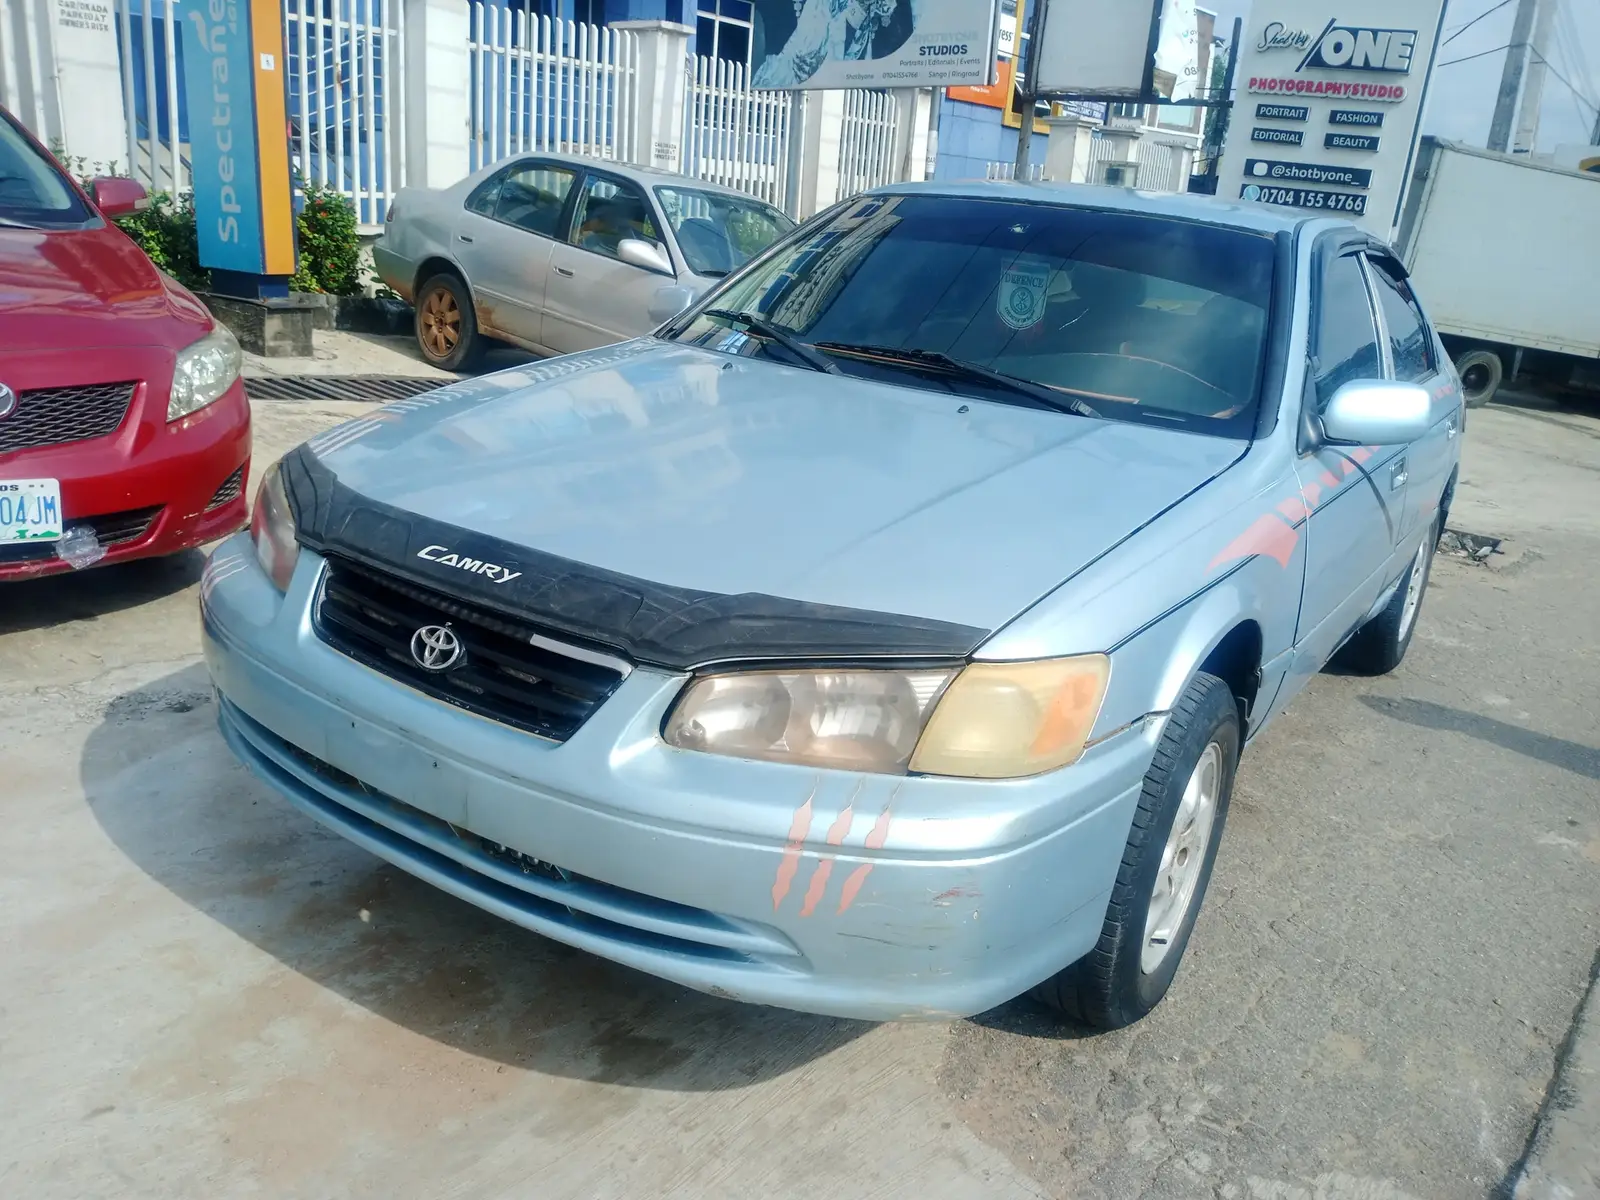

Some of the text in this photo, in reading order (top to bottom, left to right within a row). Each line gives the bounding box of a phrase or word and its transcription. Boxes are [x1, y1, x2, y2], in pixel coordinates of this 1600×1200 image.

[94, 14, 107, 23] AT
[919, 44, 968, 56] STUDIOS
[1320, 29, 1414, 71] ONE
[960, 57, 980, 66] Events
[1259, 106, 1305, 118] PORTRAIT
[1336, 112, 1378, 124] FASHION
[1253, 130, 1300, 143] EDITORIAL
[1332, 136, 1370, 148] BEAUTY
[1271, 165, 1360, 185] @shotbyone_
[1260, 188, 1363, 212] 0704 155 4766
[1004, 273, 1045, 289] DEFENCE
[416, 545, 522, 584] CAMRY
